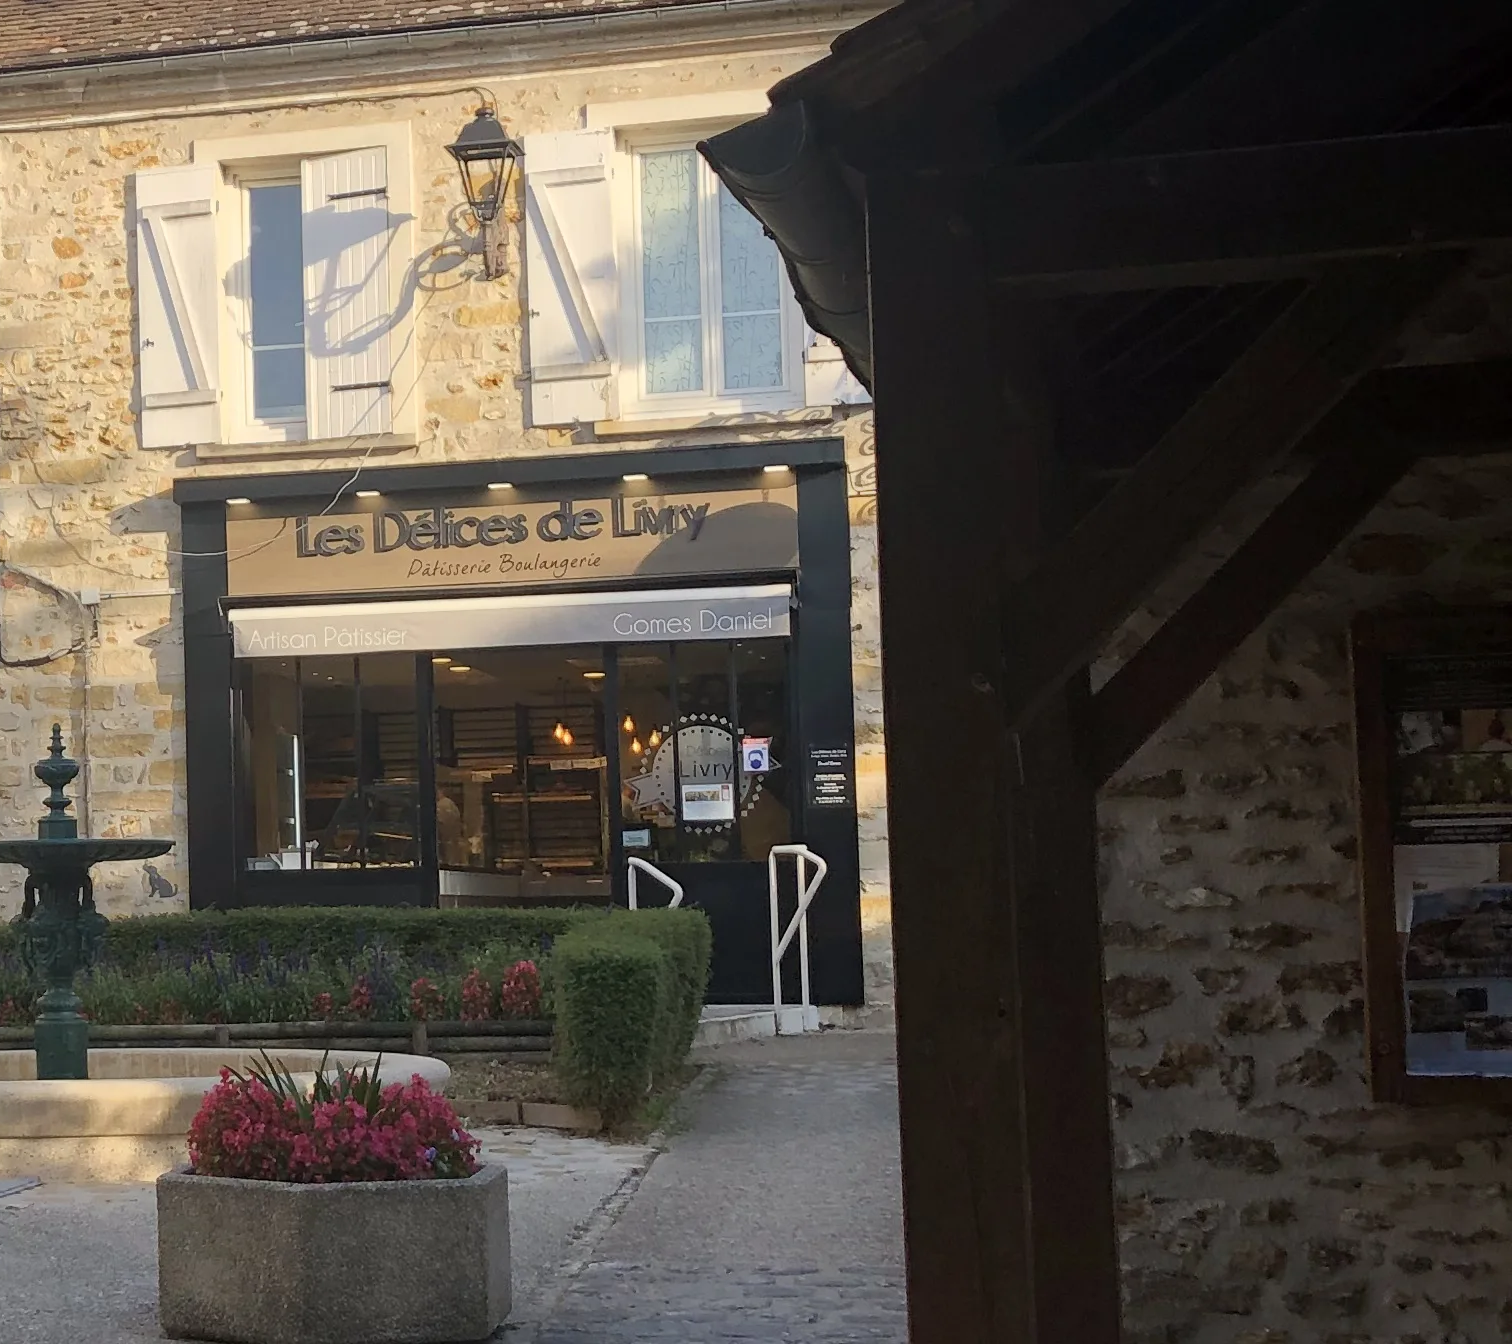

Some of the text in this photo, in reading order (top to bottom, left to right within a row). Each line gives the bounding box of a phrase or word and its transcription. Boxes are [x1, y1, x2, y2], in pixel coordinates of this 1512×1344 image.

[296, 494, 711, 558] Les Délices de Livry
[406, 553, 601, 579] Pâtisserie Boulangerie
[613, 608, 772, 635] Gomes Daniel
[248, 626, 408, 651] Artisan Pâtissier
[680, 760, 732, 780] Livry
